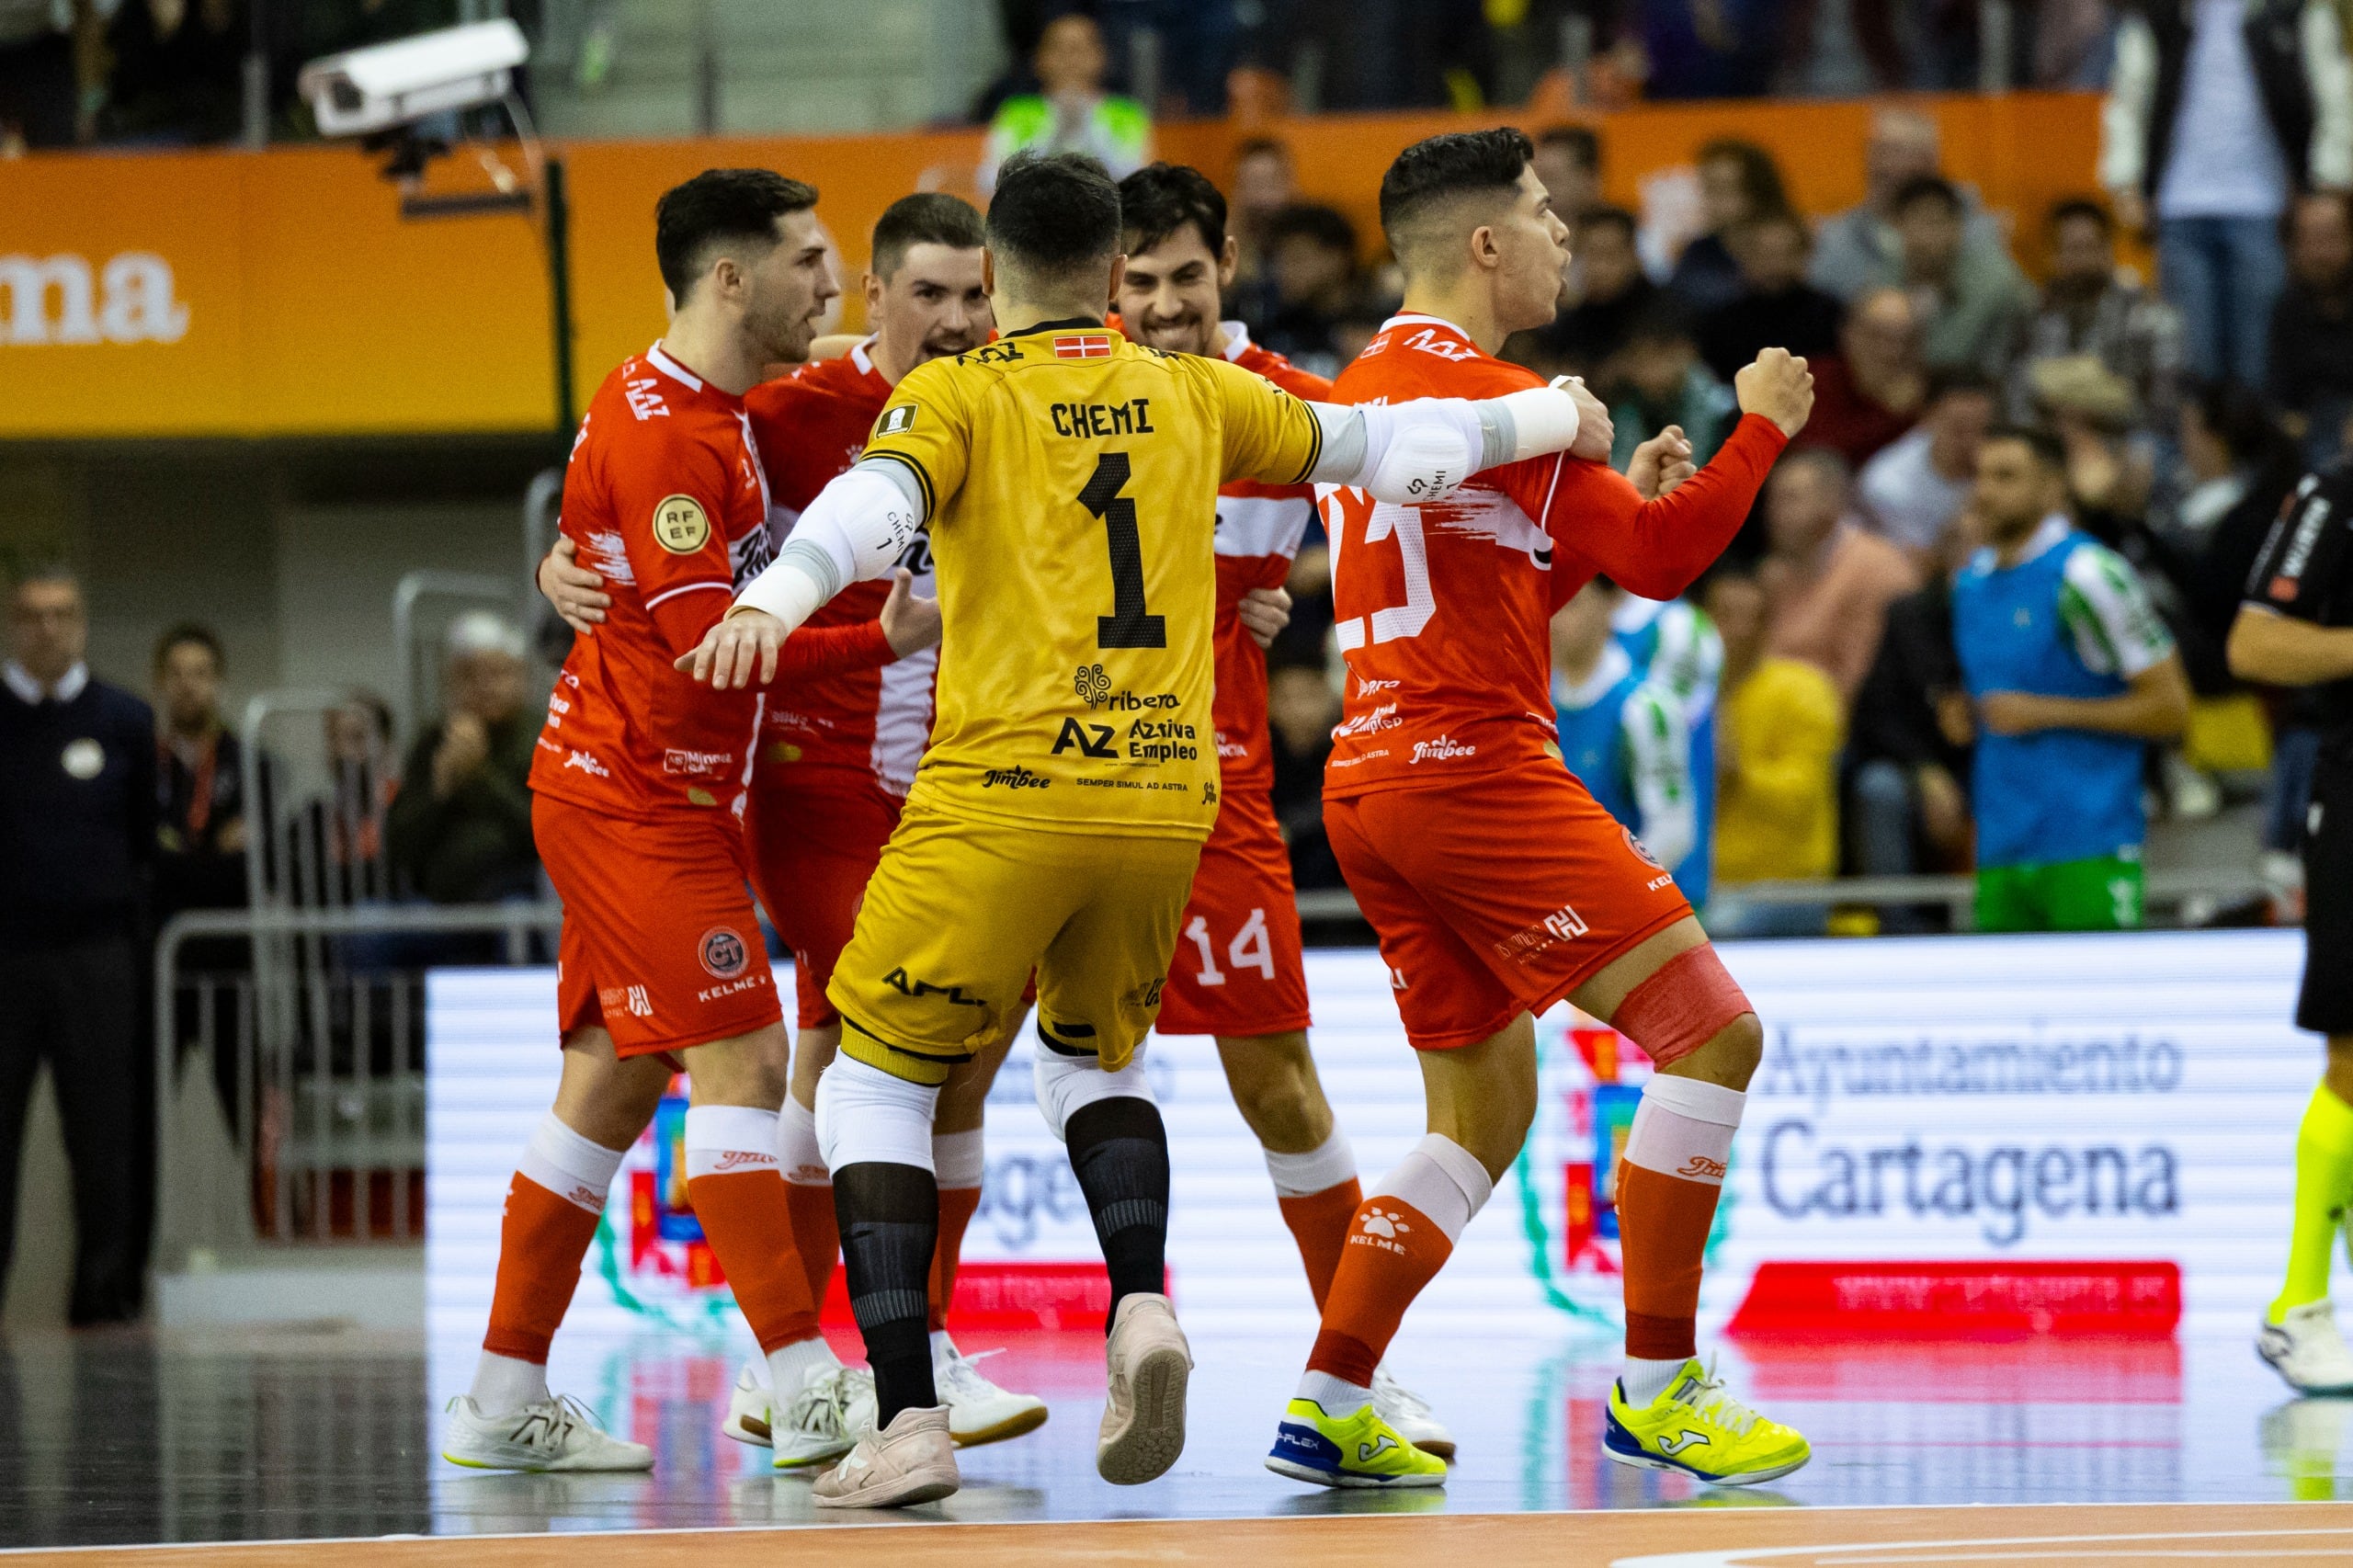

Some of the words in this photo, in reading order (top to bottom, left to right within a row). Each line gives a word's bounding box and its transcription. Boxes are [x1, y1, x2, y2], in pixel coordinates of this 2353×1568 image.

[1051, 398, 1154, 438] CHEMI
[1077, 452, 1166, 649] 1
[1108, 690, 1180, 711] ribera
[1051, 717, 1120, 758] AZ
[1129, 719, 1196, 740] Aztiva
[1130, 741, 1197, 763] Empleo
[1409, 734, 1475, 765] Jimbee
[982, 765, 1051, 790] Jimbee
[1076, 778, 1114, 788] SEMPER
[1116, 780, 1143, 789] SIMUL
[1162, 783, 1188, 791] ASTRA
[1185, 907, 1275, 986] 14
[698, 976, 756, 1003] KELME
[1760, 1024, 2182, 1116] Ayuntamiento
[1761, 1118, 2180, 1246] Cartagena
[1349, 1234, 1406, 1256] KELME
